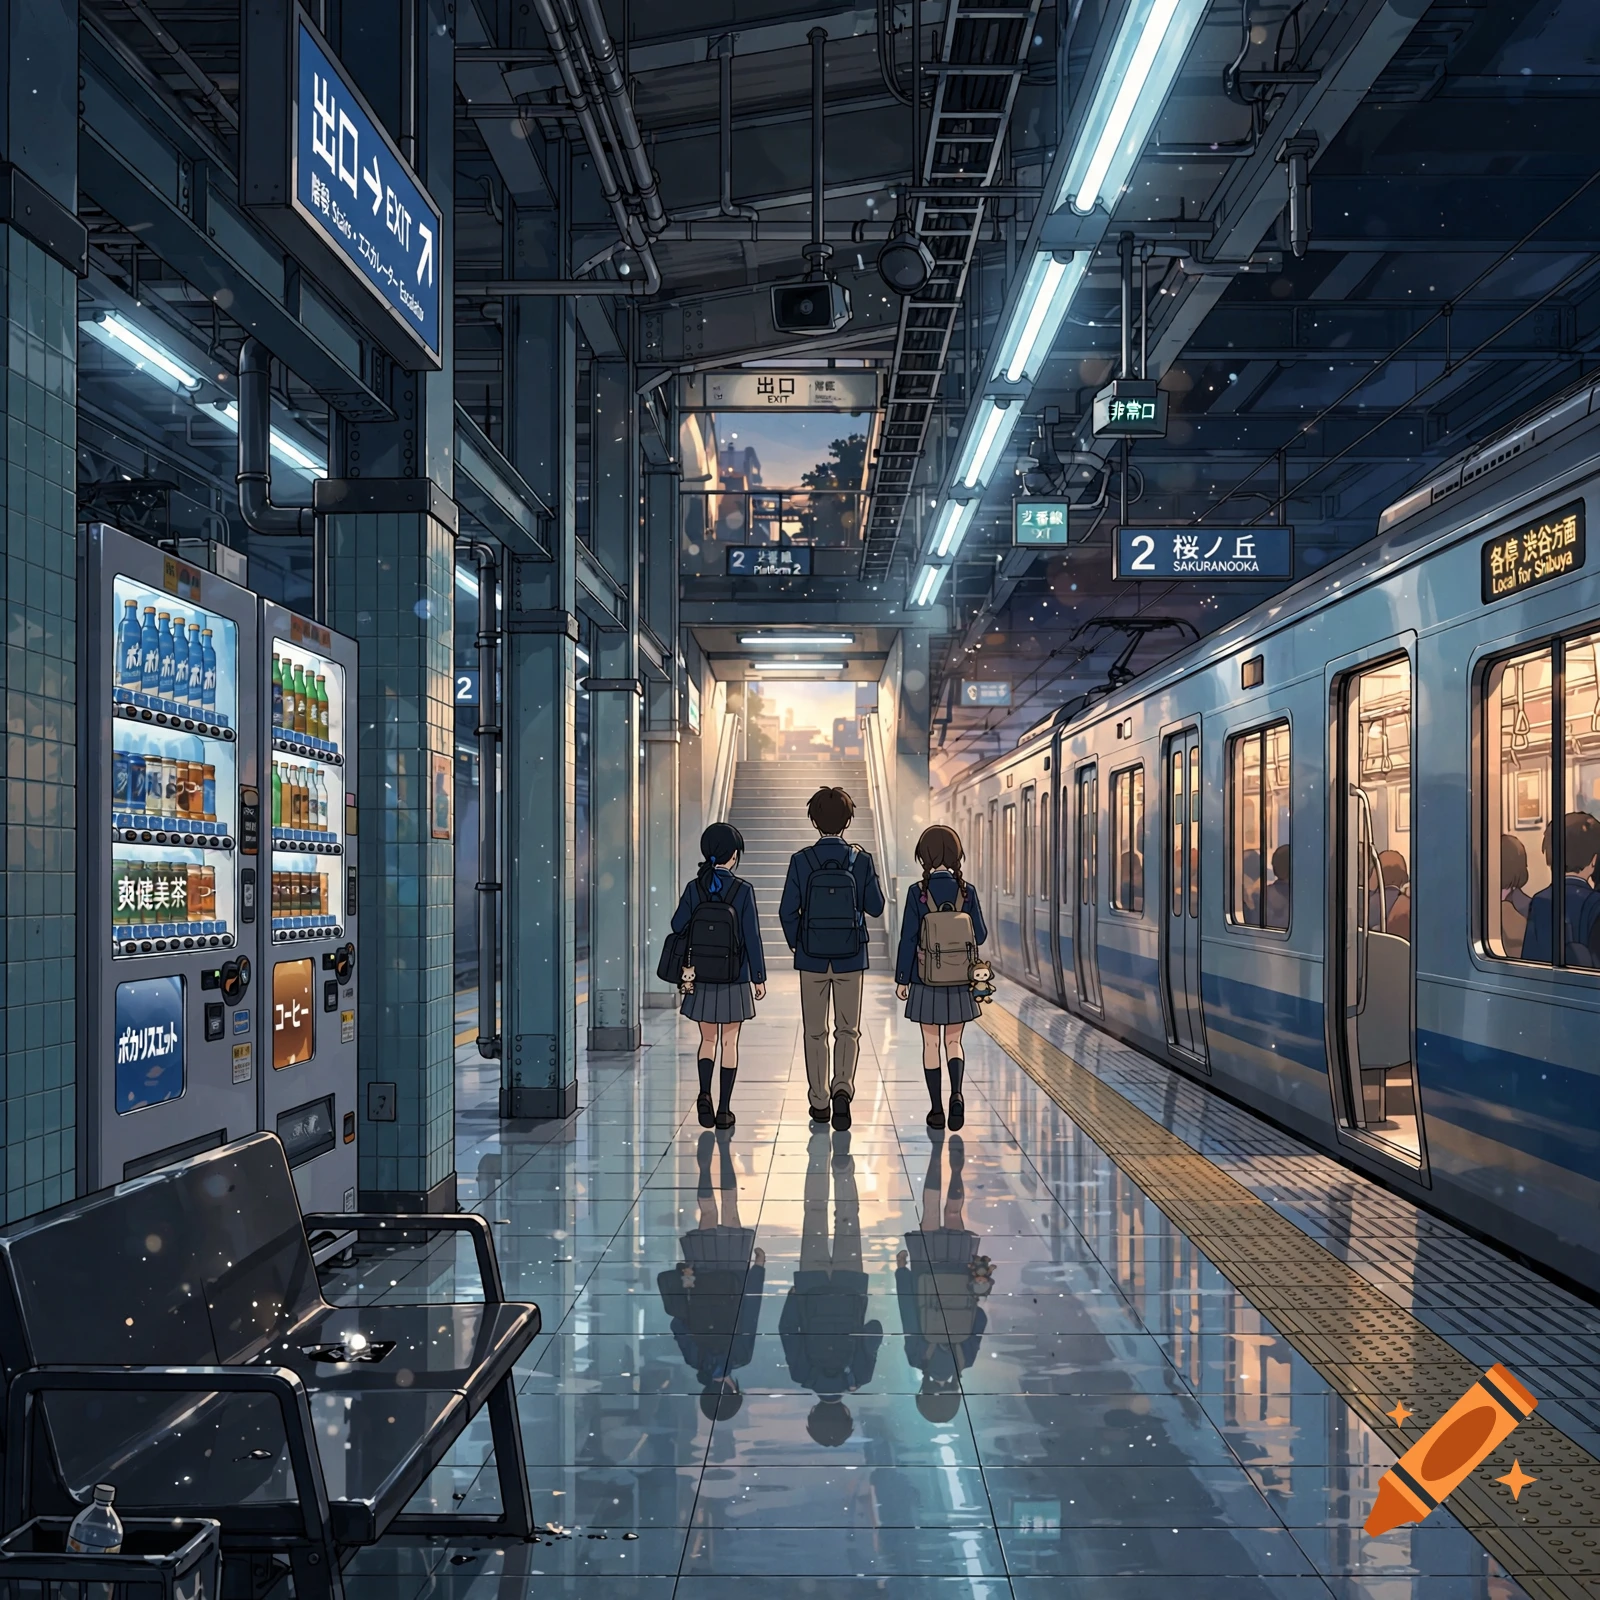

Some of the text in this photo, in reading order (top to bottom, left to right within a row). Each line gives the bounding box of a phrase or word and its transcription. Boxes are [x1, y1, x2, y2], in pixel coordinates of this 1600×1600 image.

[312, 71, 412, 253] 出口 EXIT
[757, 376, 795, 395] 出口
[767, 395, 790, 404] EXIT
[1110, 399, 1155, 421] 非常口
[732, 550, 745, 568] 2
[1131, 534, 1256, 571] 2 桜ノ丘
[1490, 537, 1519, 576] 各停
[793, 563, 801, 575] 2
[1173, 560, 1259, 573] SAKURANOOKA
[1492, 569, 1517, 594] Local
[1518, 566, 1532, 584] for
[457, 676, 473, 700] 2
[117, 875, 188, 912] 爽健美茶
[275, 999, 309, 1031] コーヒー
